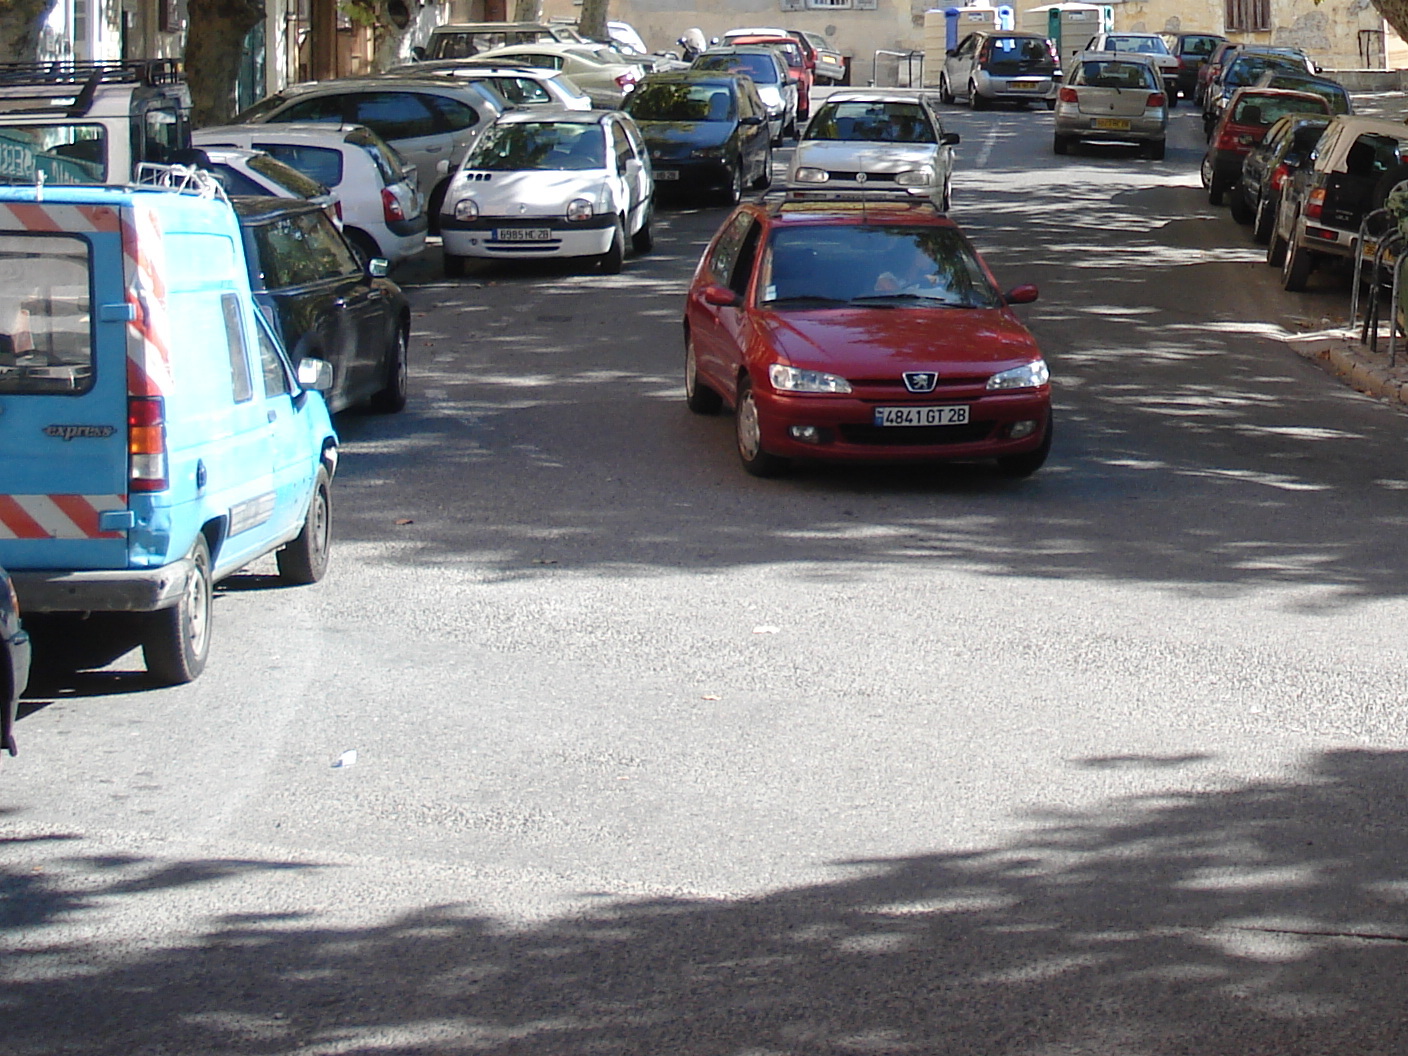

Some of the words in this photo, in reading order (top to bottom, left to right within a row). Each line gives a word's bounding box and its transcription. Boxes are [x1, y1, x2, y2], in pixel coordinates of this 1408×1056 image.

[885, 409, 921, 424] 4841
[926, 408, 944, 424] GT
[947, 408, 966, 423] 2B
[45, 425, 115, 441] express
